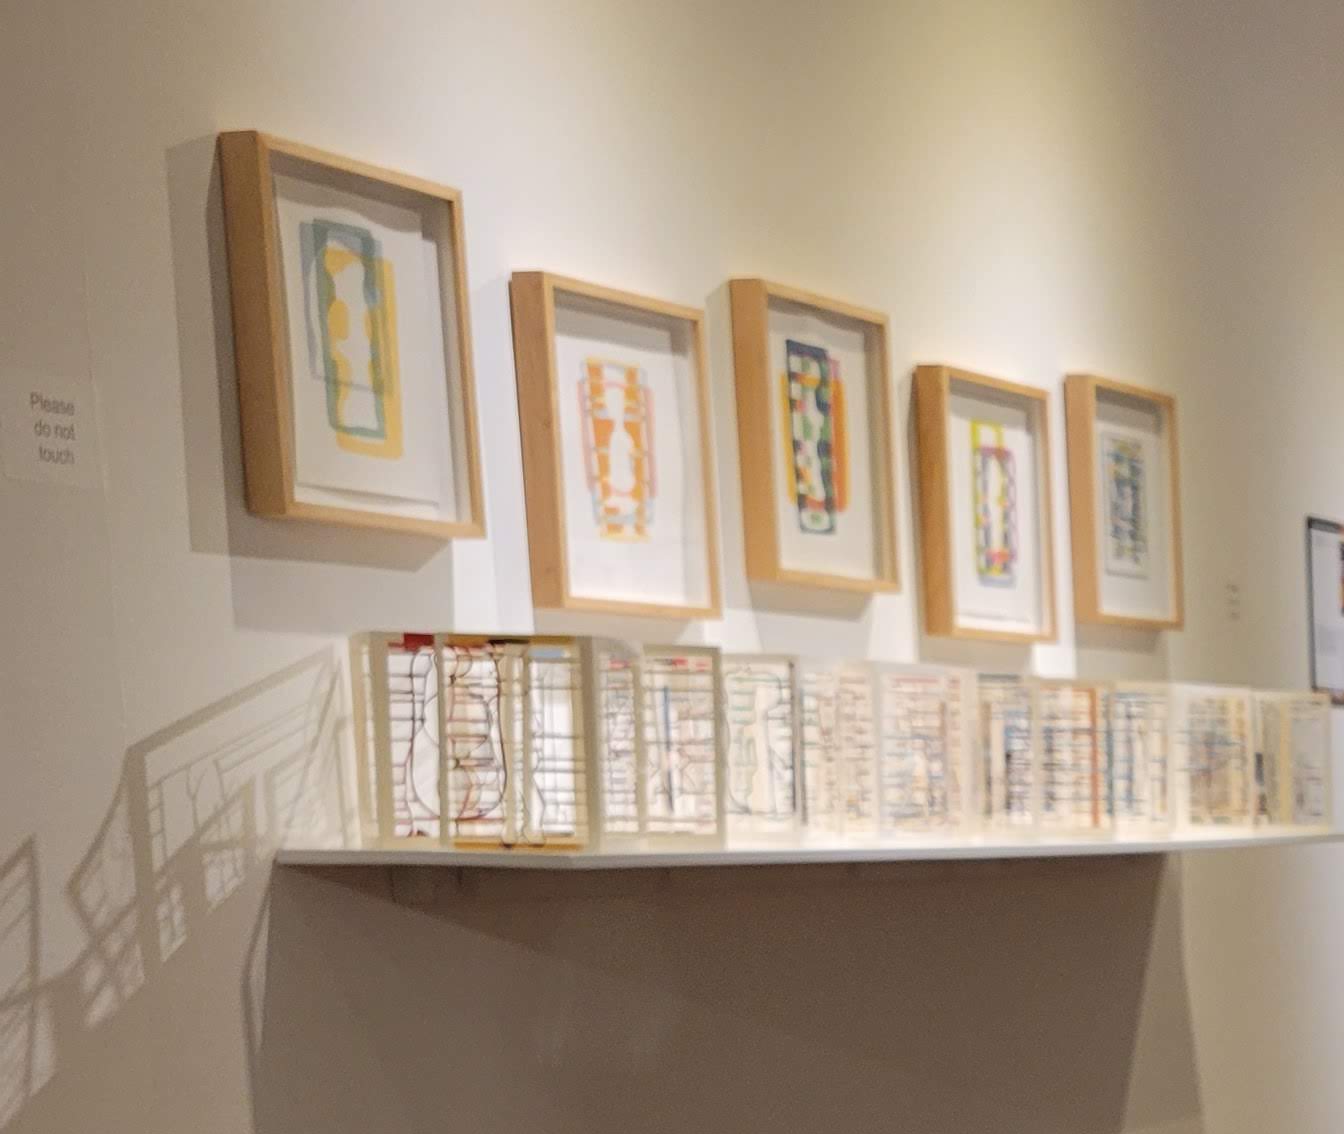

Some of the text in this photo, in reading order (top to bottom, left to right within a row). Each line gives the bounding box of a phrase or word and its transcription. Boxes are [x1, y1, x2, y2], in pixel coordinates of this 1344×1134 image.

[29, 391, 75, 418] Please
[34, 418, 76, 442] do not
[38, 442, 75, 466] touch
